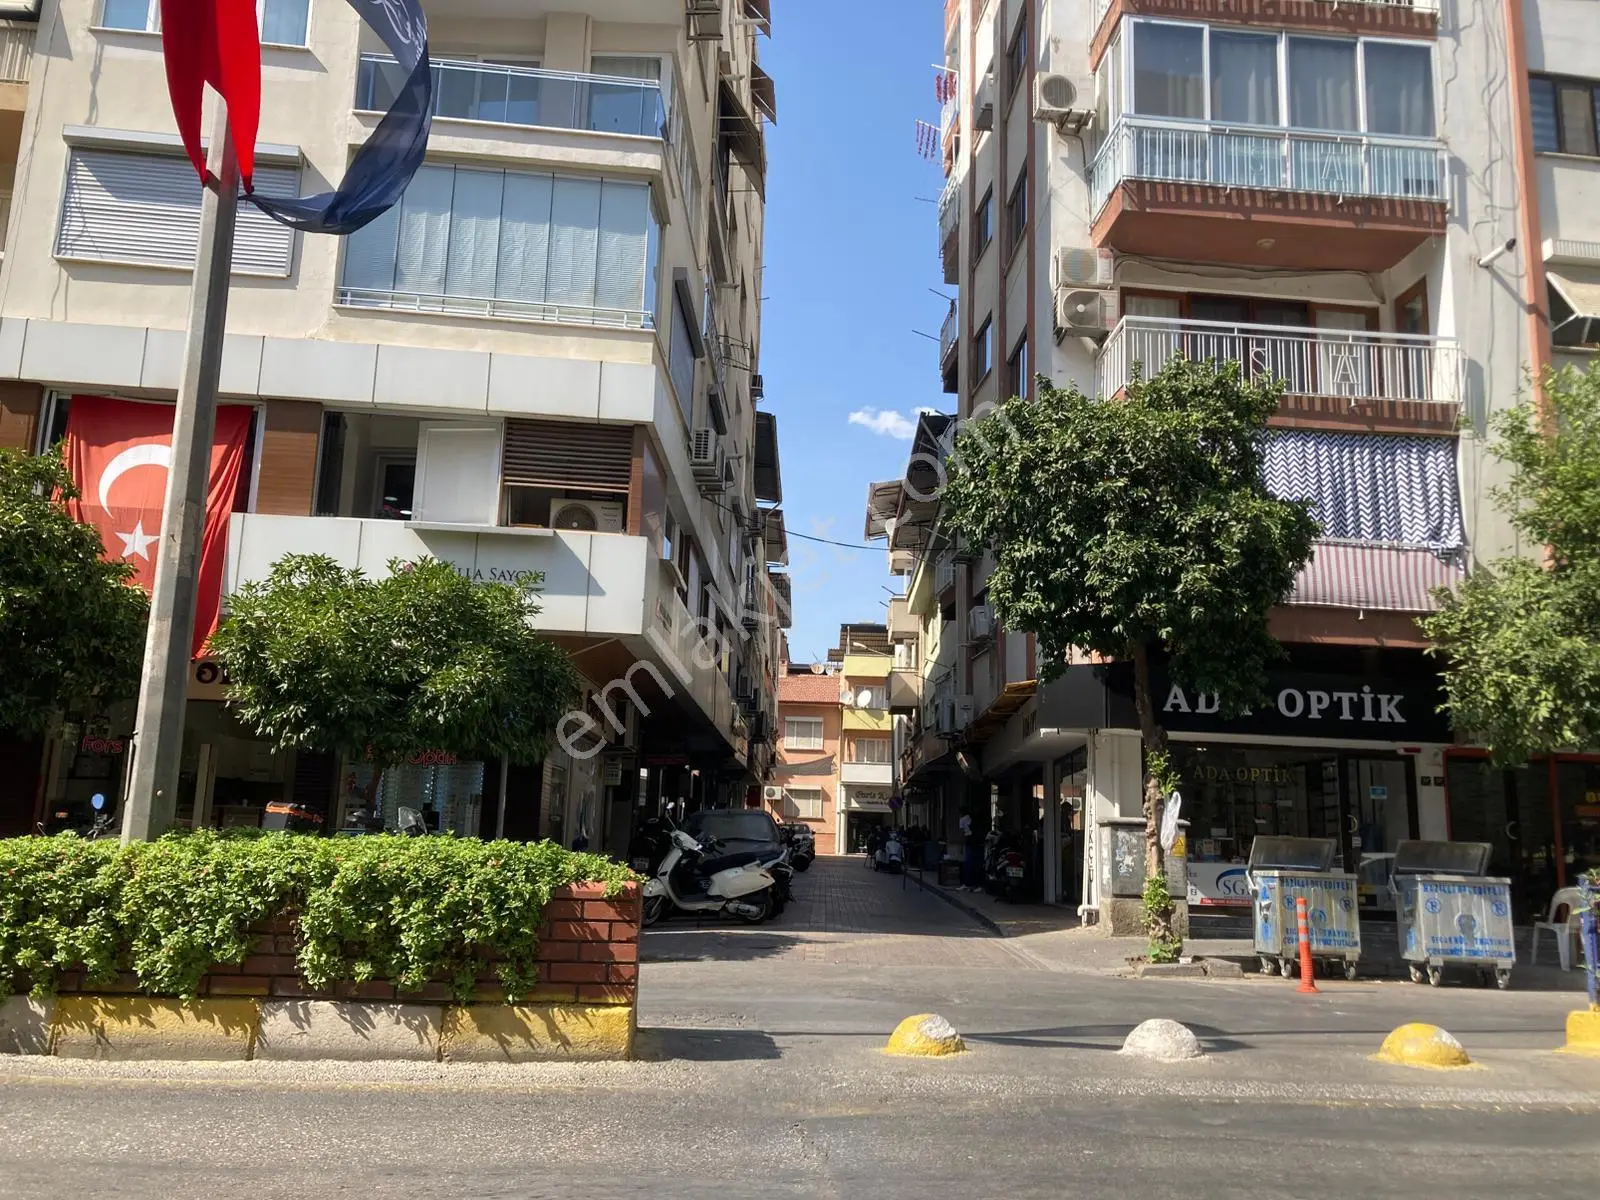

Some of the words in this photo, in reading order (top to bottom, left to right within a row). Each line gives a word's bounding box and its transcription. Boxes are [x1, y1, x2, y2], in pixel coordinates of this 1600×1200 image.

[1163, 684, 1253, 716] AD
[1277, 684, 1407, 723] OPTİK
[1193, 766, 1232, 781] ADA
[1236, 764, 1296, 783] OPTİK
